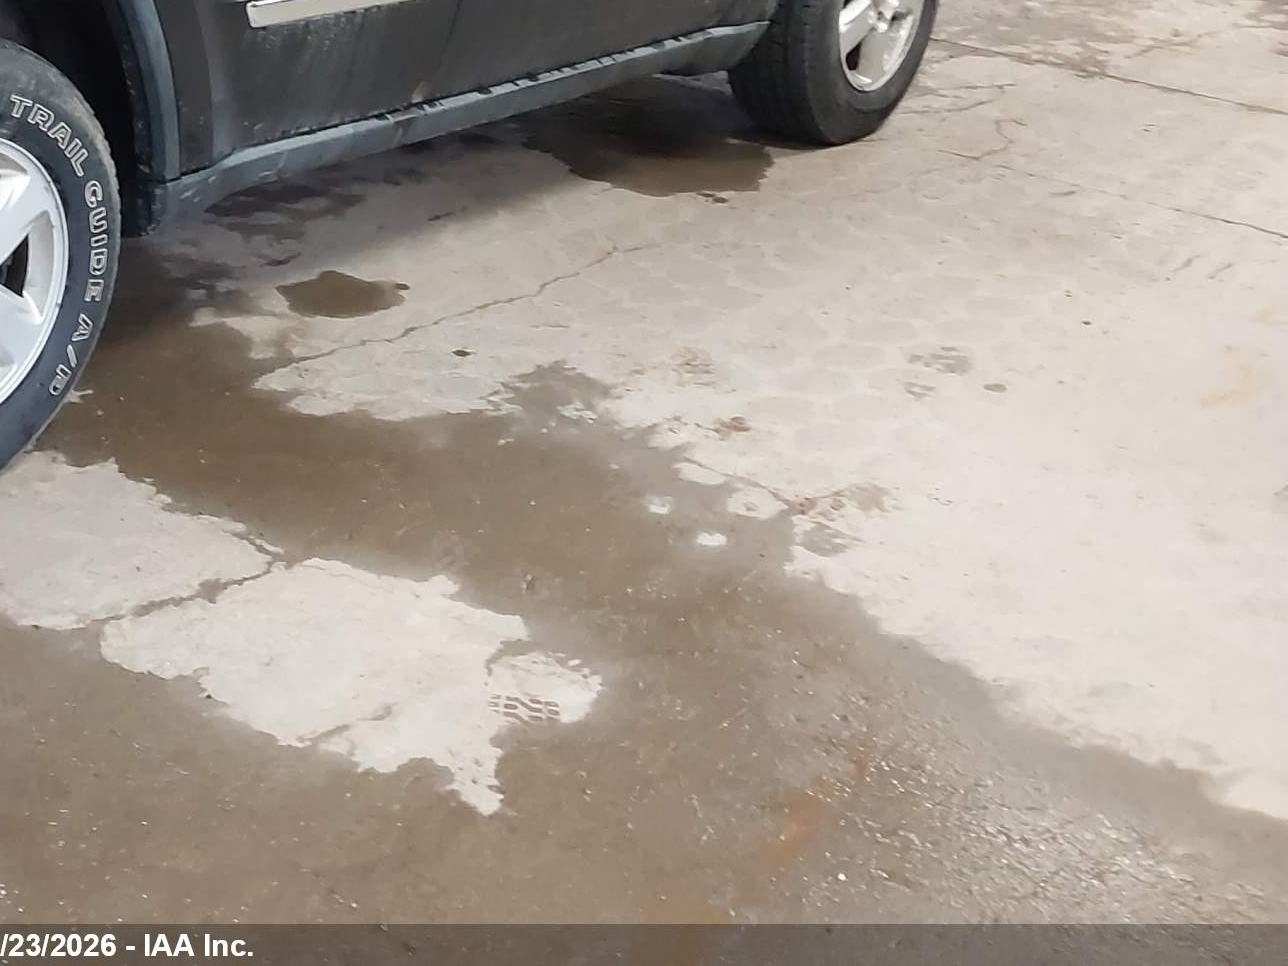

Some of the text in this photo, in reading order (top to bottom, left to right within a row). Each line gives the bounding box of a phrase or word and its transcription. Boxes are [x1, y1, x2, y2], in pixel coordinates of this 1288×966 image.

[9, 94, 109, 396] TRAIL GUIDE A/P
